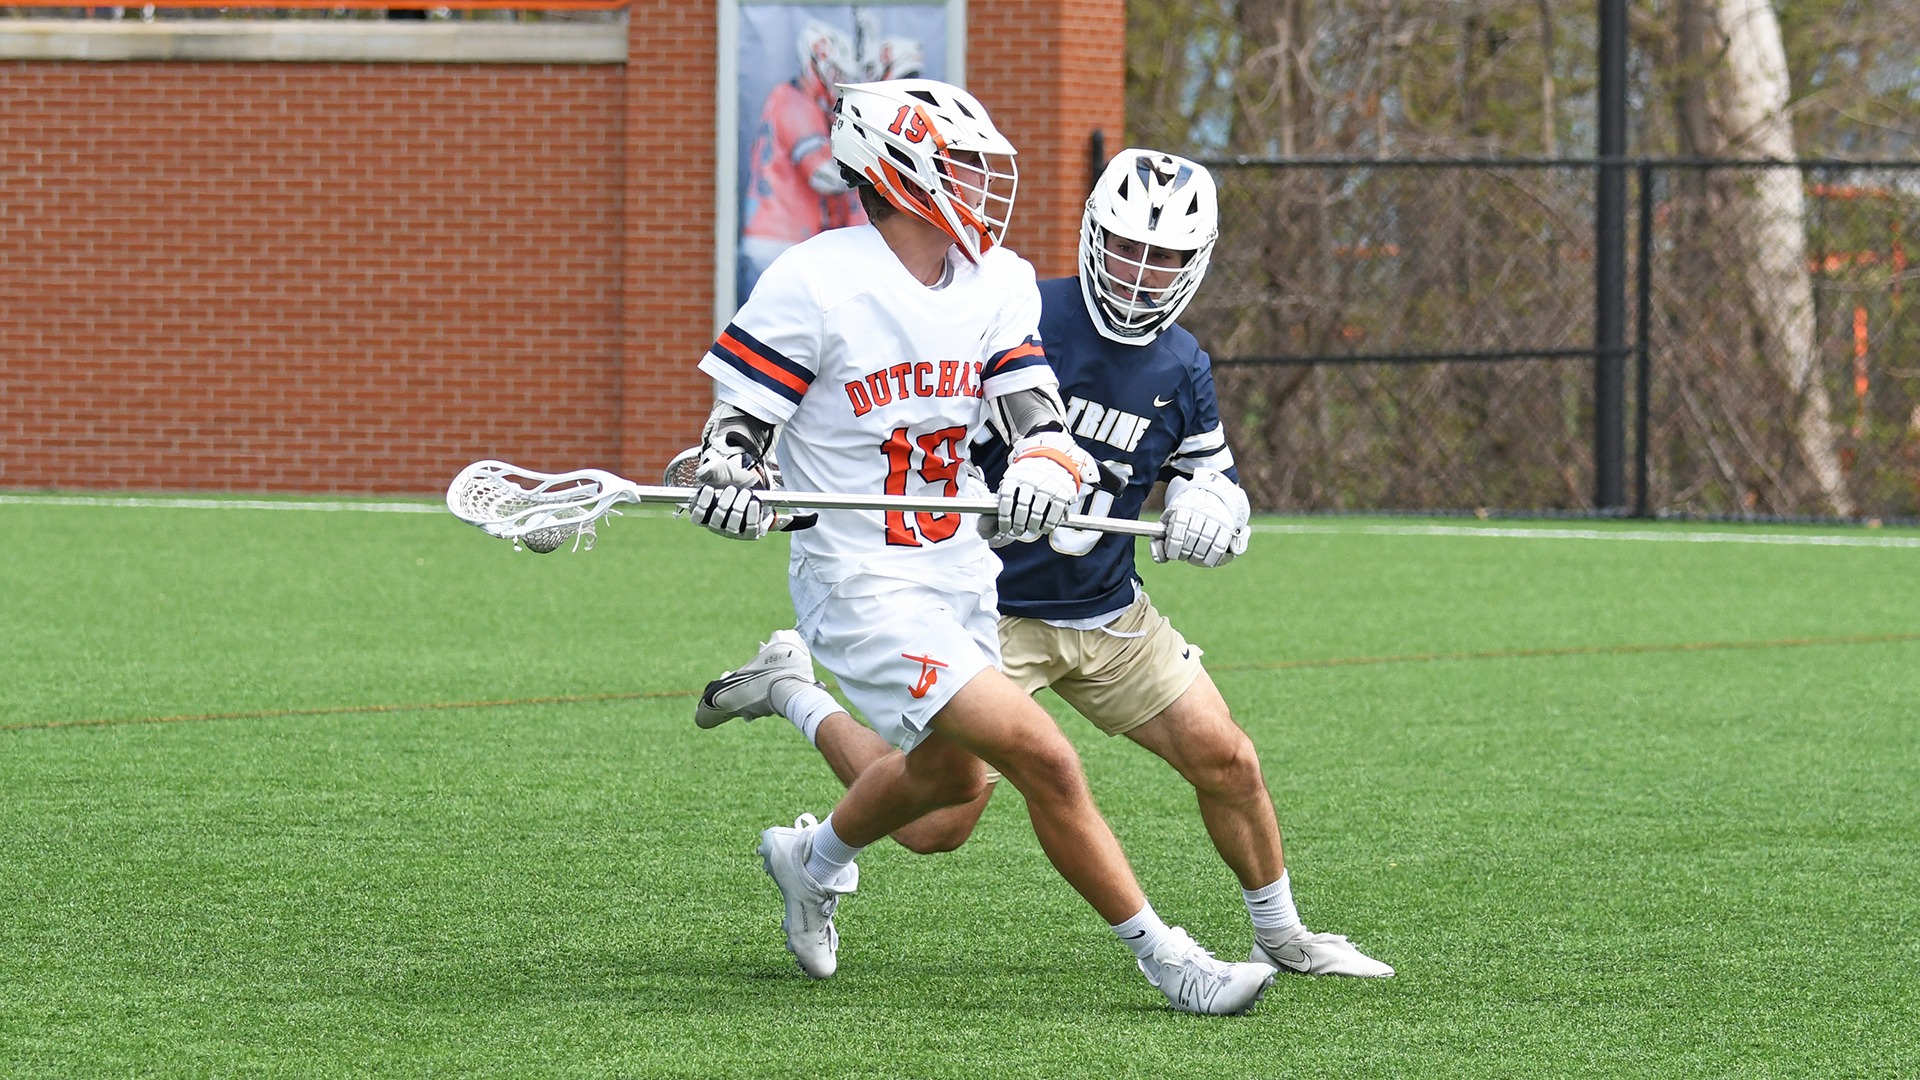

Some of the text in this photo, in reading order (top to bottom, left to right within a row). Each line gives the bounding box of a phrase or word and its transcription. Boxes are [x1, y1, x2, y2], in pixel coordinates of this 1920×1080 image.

[888, 104, 928, 144] 19
[1066, 395, 1152, 453] TRINE
[880, 424, 968, 547] 19
